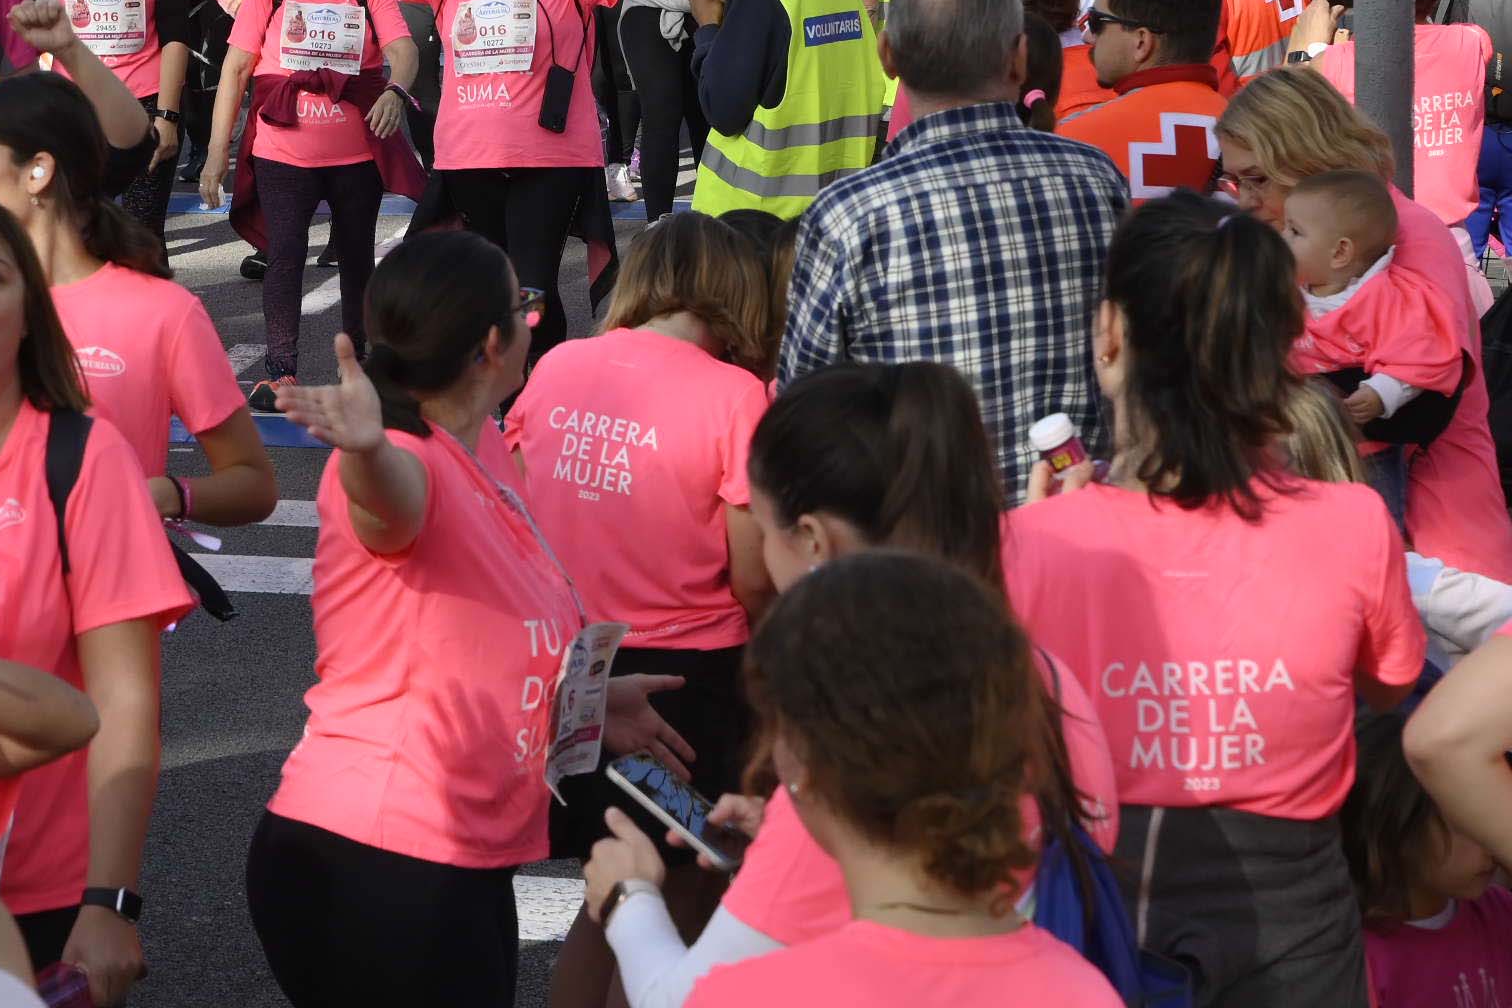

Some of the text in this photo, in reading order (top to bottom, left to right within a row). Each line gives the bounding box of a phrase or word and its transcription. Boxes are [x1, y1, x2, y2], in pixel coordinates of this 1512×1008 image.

[93, 12, 119, 22] 016
[309, 29, 336, 41] 016
[479, 24, 507, 37] 016
[805, 17, 861, 40] VOLUNTARIS
[311, 42, 332, 50] 10273
[482, 39, 505, 47] 10272
[457, 83, 510, 104] SUMA
[296, 100, 345, 118] UMA
[1440, 111, 1461, 128] LA
[548, 405, 658, 451] CARRERA
[561, 433, 631, 469] DE LA
[552, 456, 633, 495] MUJER
[577, 489, 601, 501] 2023
[523, 617, 562, 657] TU
[1102, 657, 1296, 698] CARRERA
[1138, 697, 1258, 733] DE LA
[1130, 733, 1267, 771] MUJER
[1183, 776, 1222, 792] 2023
